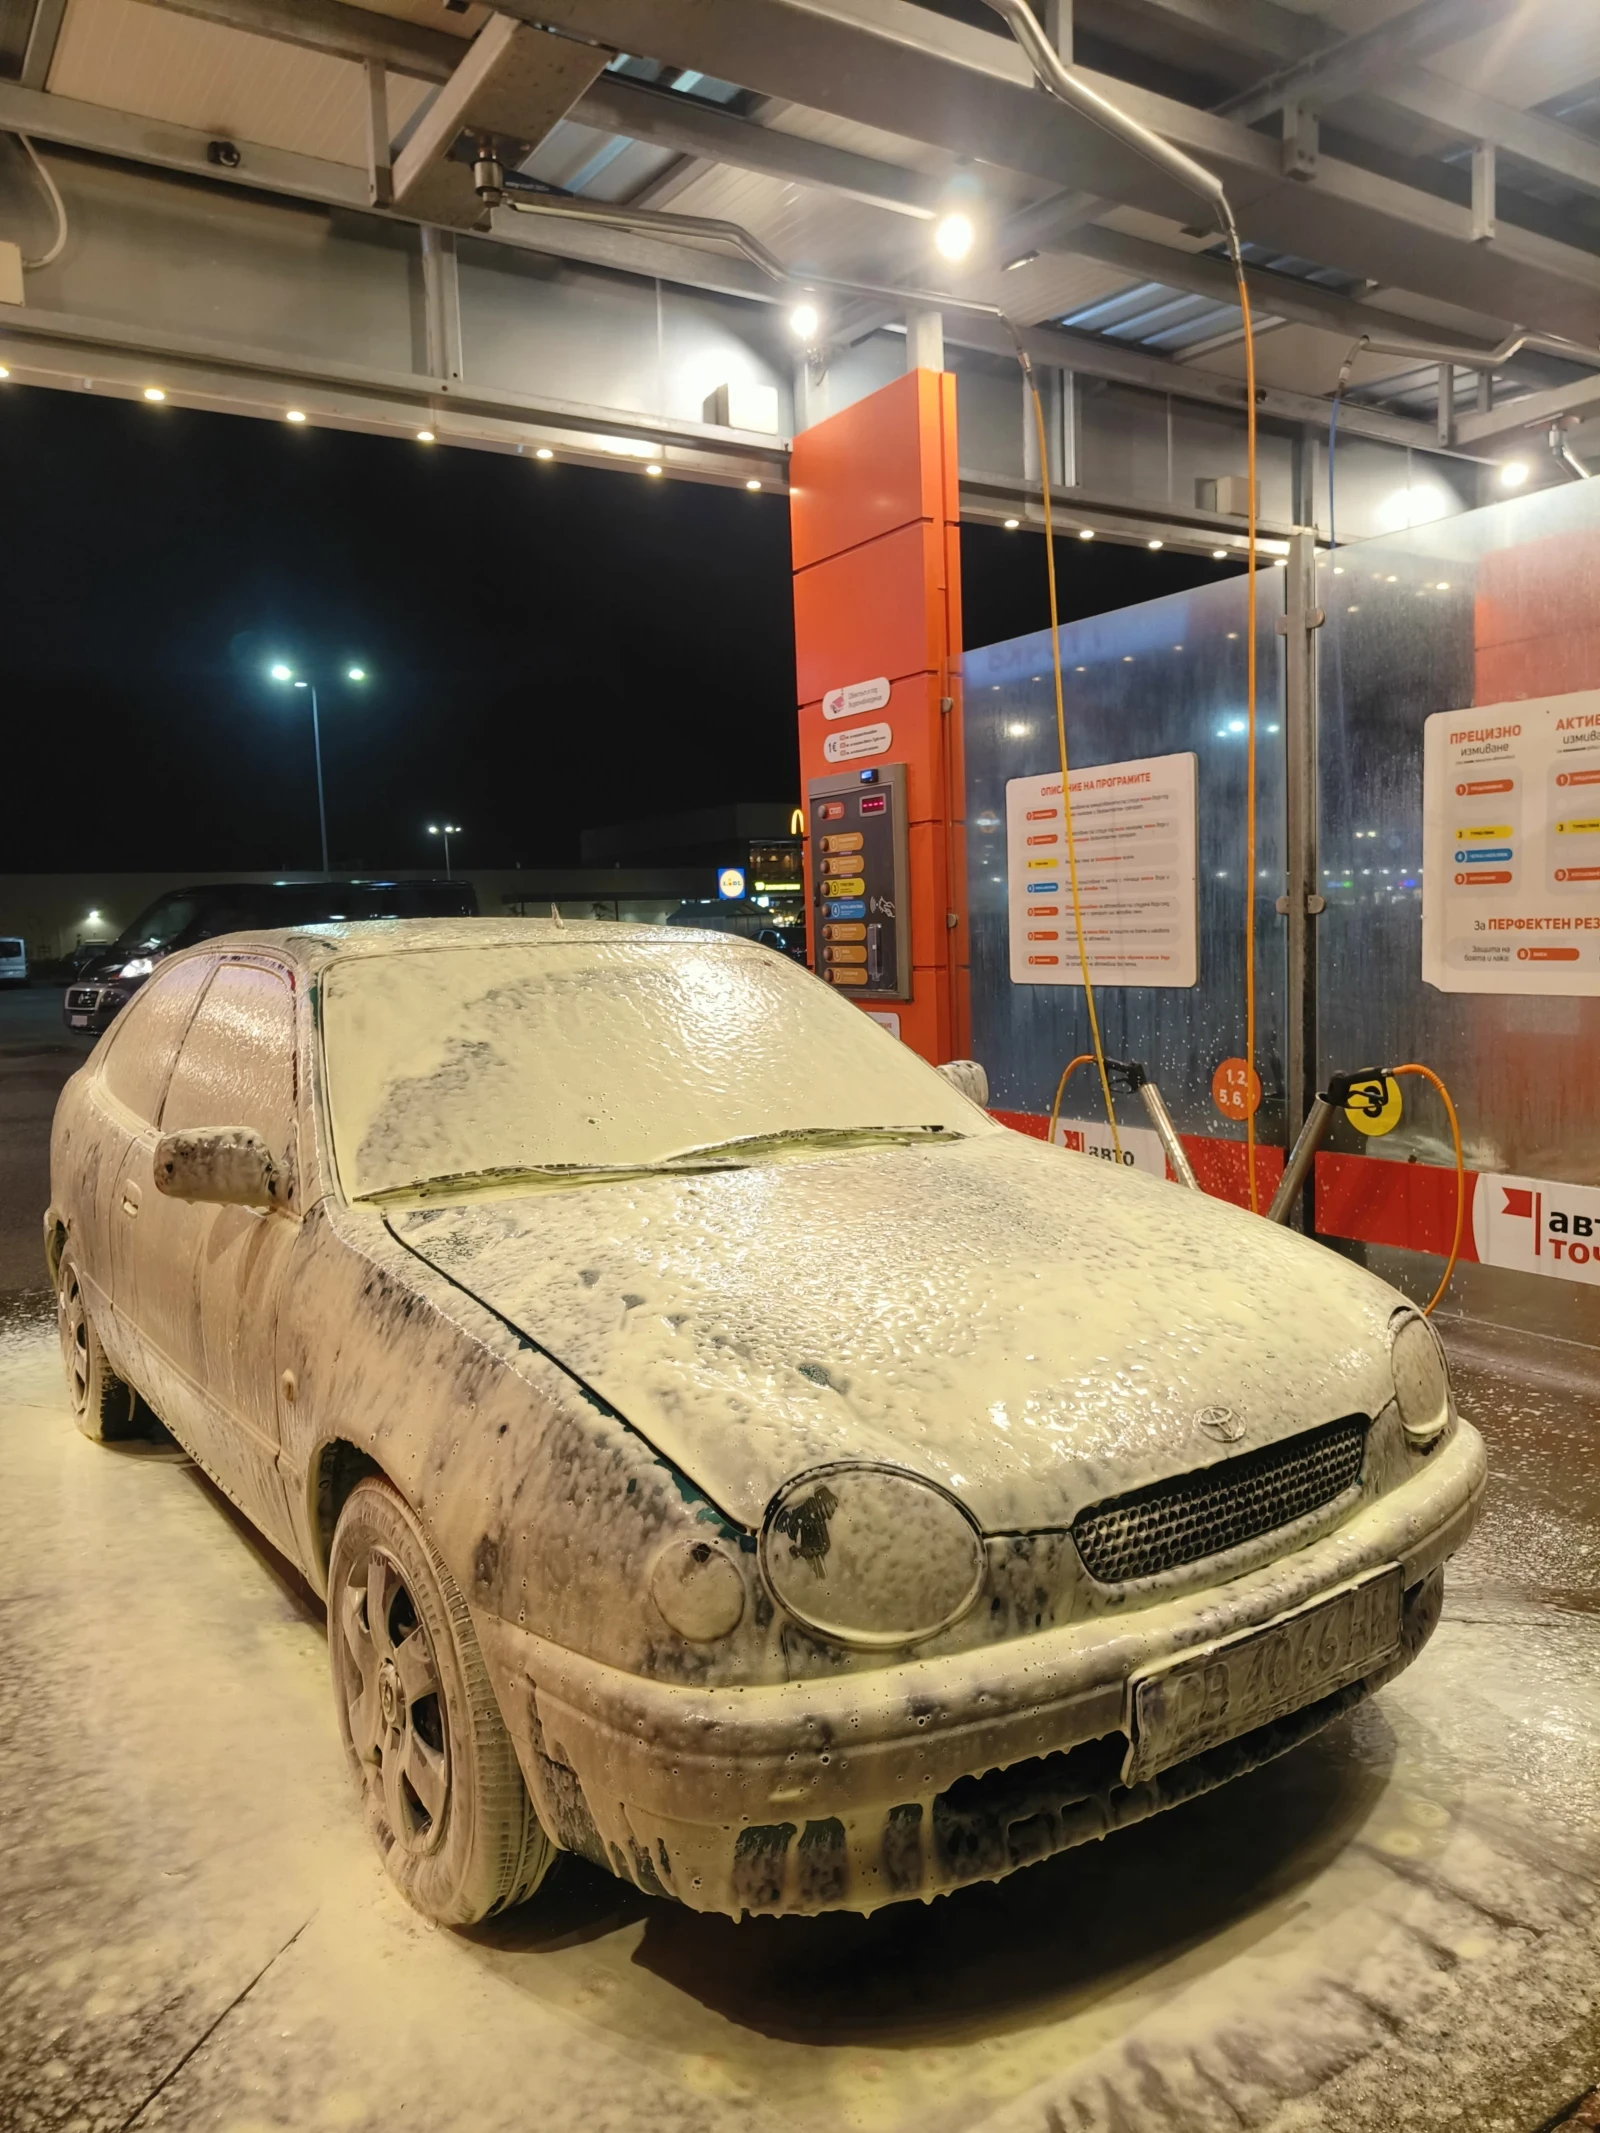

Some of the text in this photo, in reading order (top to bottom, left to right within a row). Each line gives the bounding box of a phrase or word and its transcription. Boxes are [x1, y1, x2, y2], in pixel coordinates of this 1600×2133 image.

[1450, 724, 1522, 745] ПРЕЦИЗНО
[1460, 743, 1510, 757] измиване
[1083, 781, 1095, 791] НА
[1096, 772, 1151, 789] ПРОГРАМИТЕ
[1474, 920, 1486, 931] За
[1488, 917, 1571, 930] ПЕРФЕКТЕН
